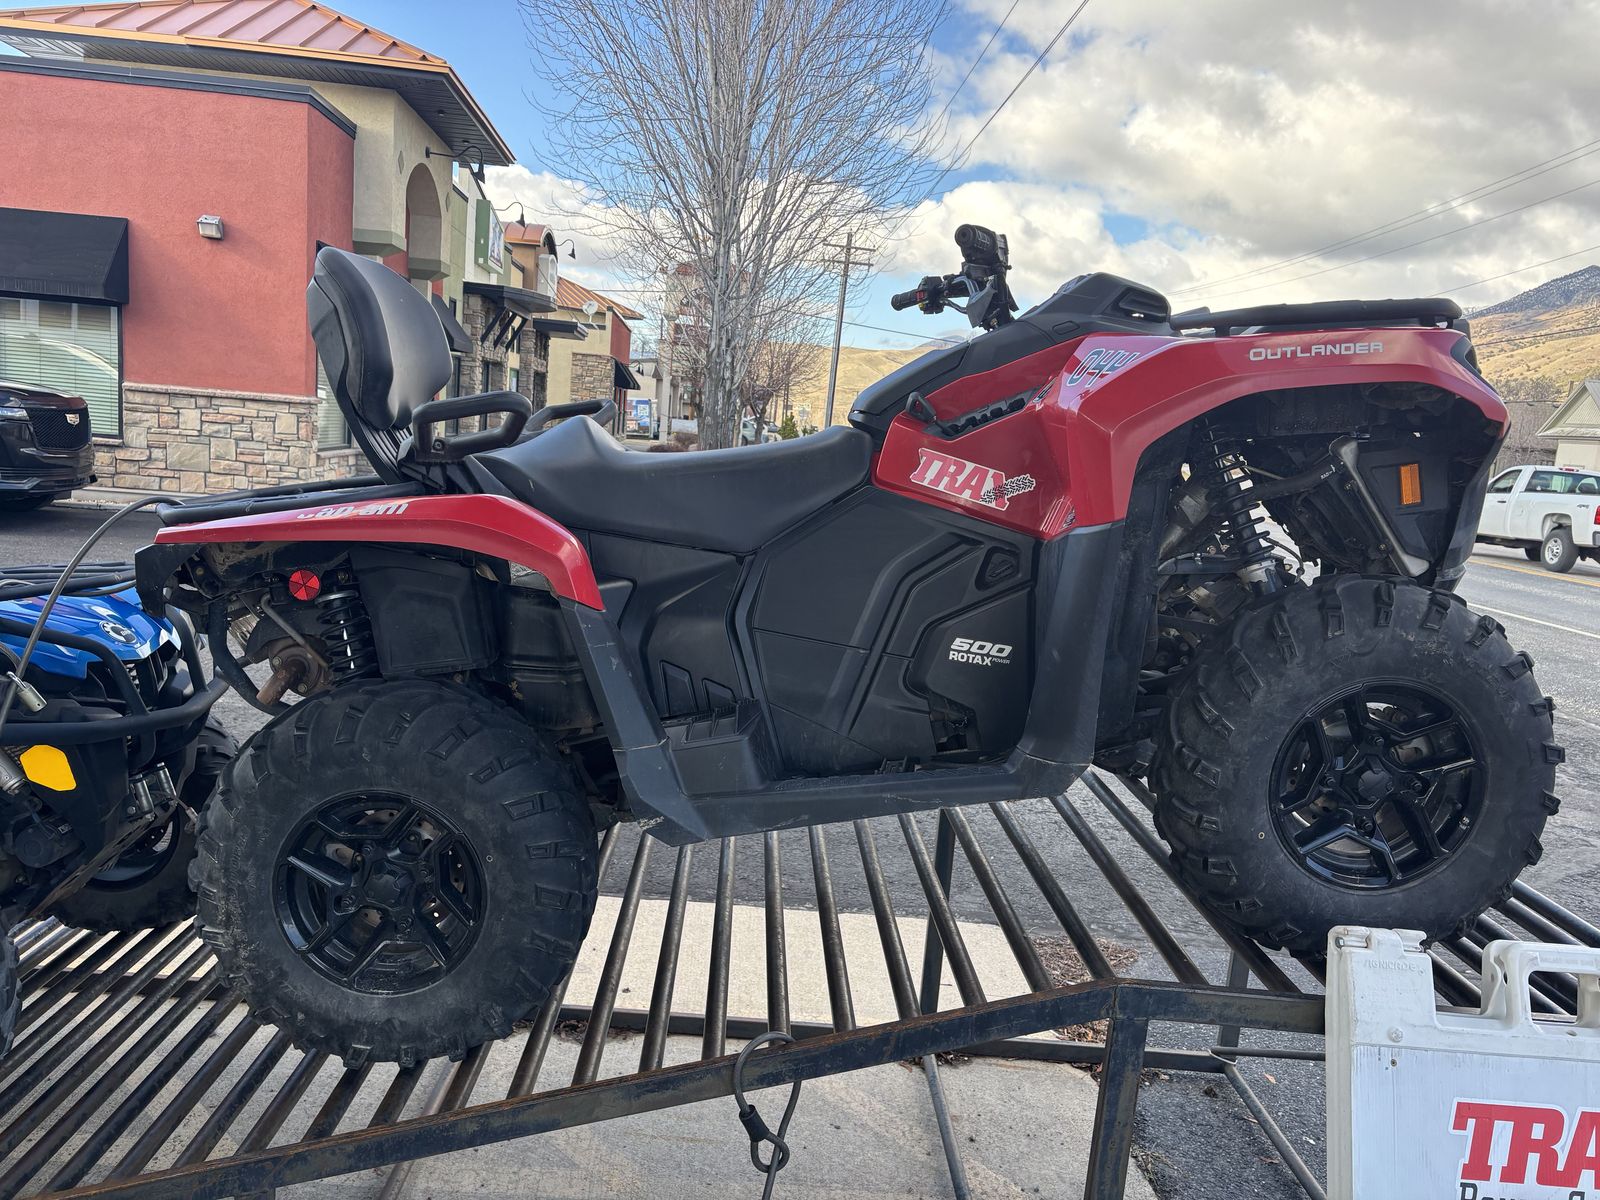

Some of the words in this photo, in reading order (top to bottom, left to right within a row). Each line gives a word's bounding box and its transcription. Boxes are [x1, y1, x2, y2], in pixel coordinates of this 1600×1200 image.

[1249, 342, 1384, 361] OUTLANDER
[911, 449, 1035, 511] TRAX
[950, 637, 1013, 658] 500
[949, 650, 992, 666] ROTAX
